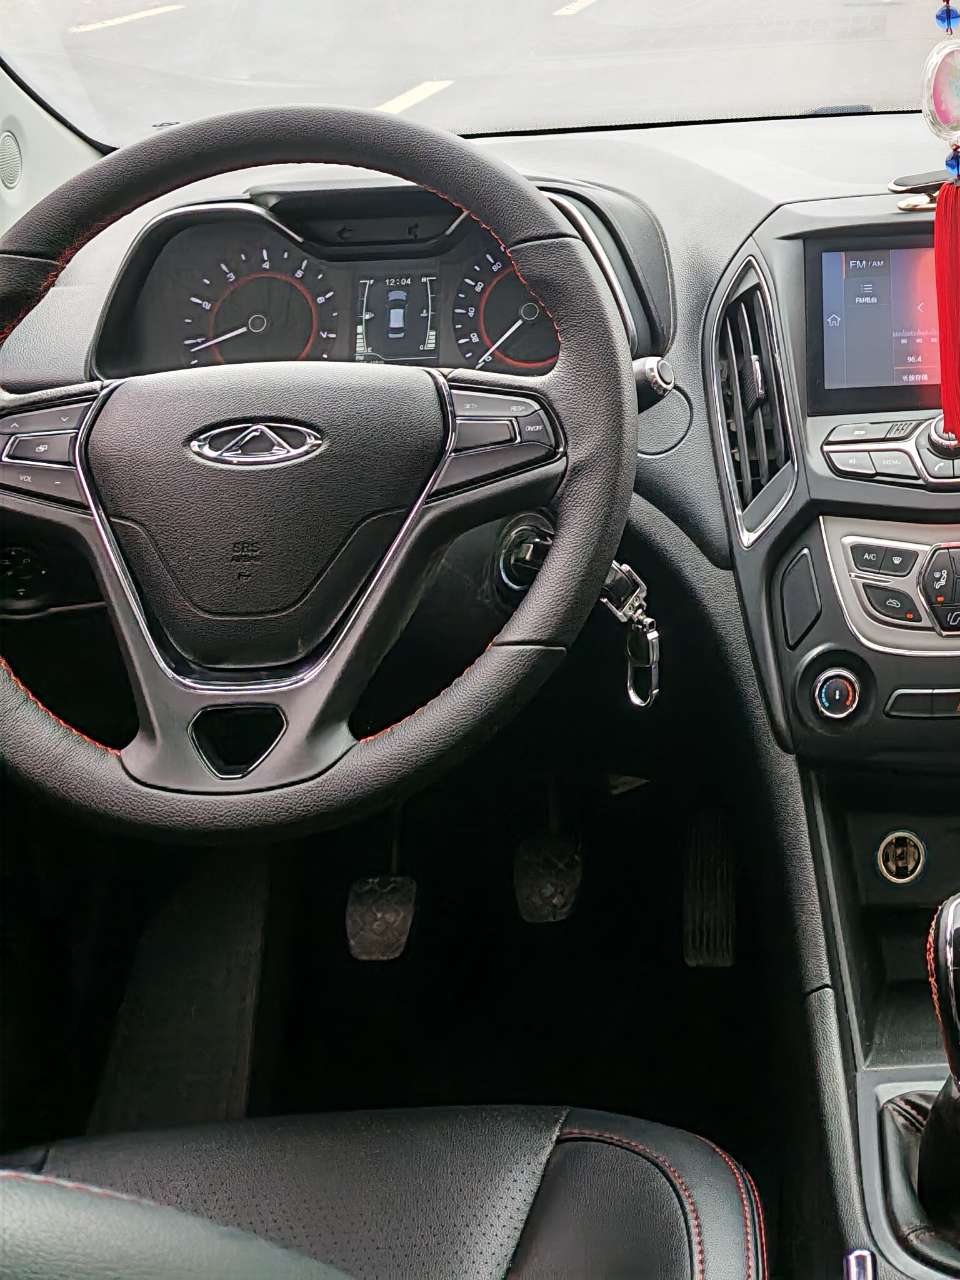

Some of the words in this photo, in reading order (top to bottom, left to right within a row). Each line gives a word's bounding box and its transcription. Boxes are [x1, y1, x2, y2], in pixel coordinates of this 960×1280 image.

[262, 261, 270, 270] 4
[849, 260, 866, 269] FM
[226, 273, 236, 282] 3
[294, 269, 304, 279] 5
[385, 278, 411, 286] 12:04
[467, 306, 476, 318] 40
[863, 552, 877, 561] A/C
